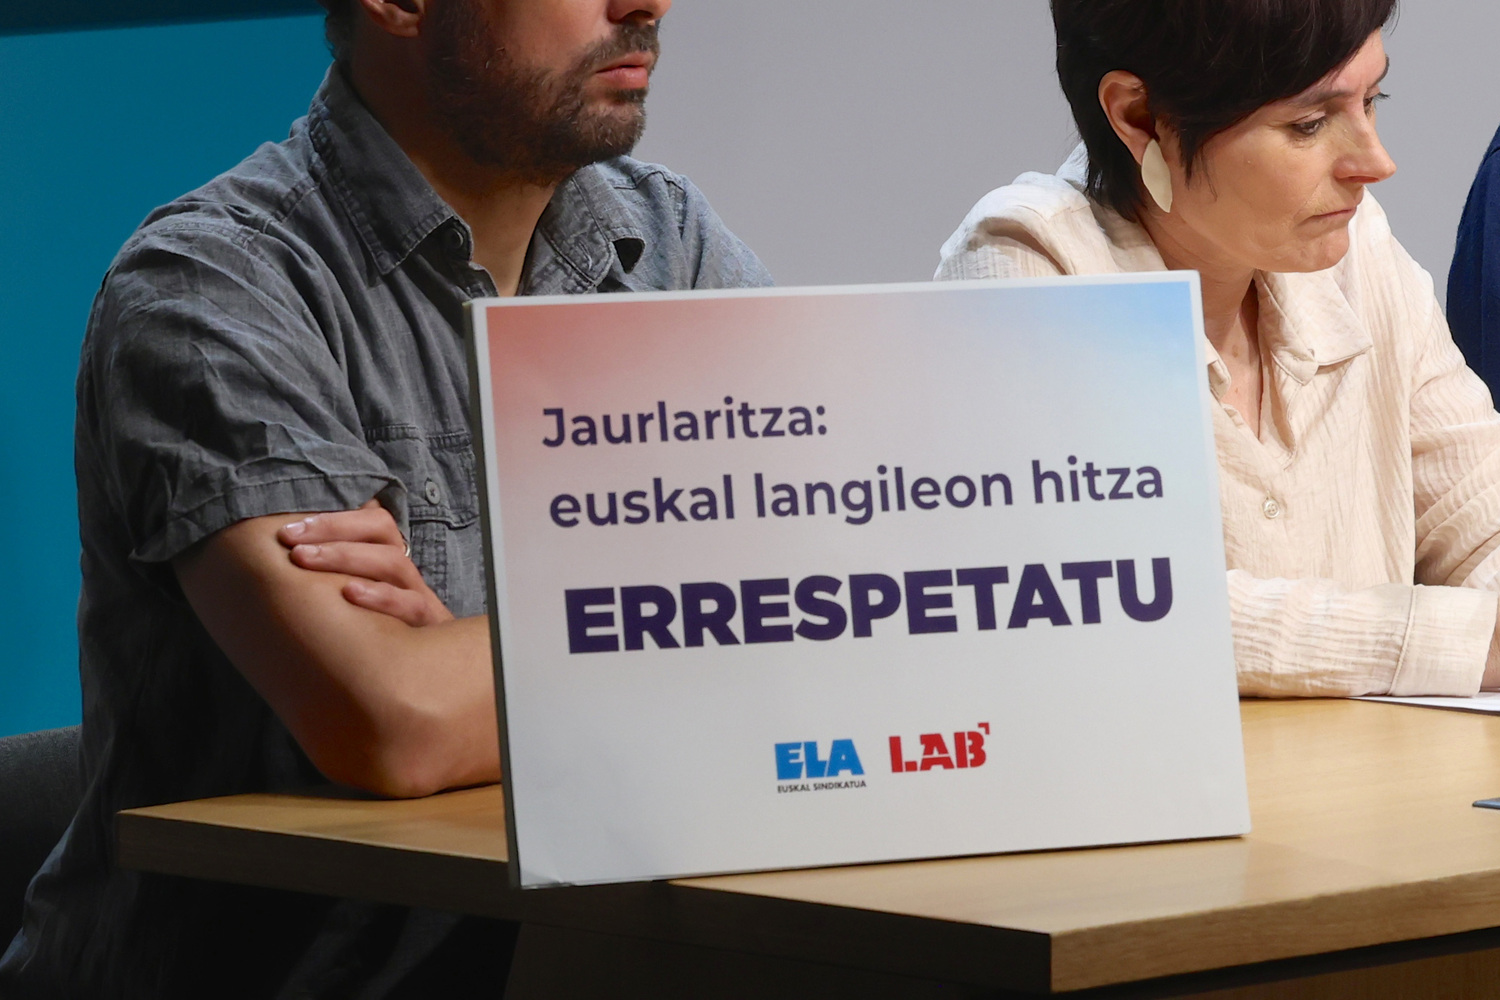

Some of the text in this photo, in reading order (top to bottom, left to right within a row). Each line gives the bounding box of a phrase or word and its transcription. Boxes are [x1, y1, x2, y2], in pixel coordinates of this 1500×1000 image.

[542, 396, 827, 448] Jaurlaritza:
[550, 455, 1164, 528] euskal langileon hitza
[563, 557, 1173, 655] ERRESPETATU
[774, 738, 866, 781] ELA
[888, 730, 988, 773] LAB
[777, 781, 867, 794] EUSKAL SINDIKATUA
